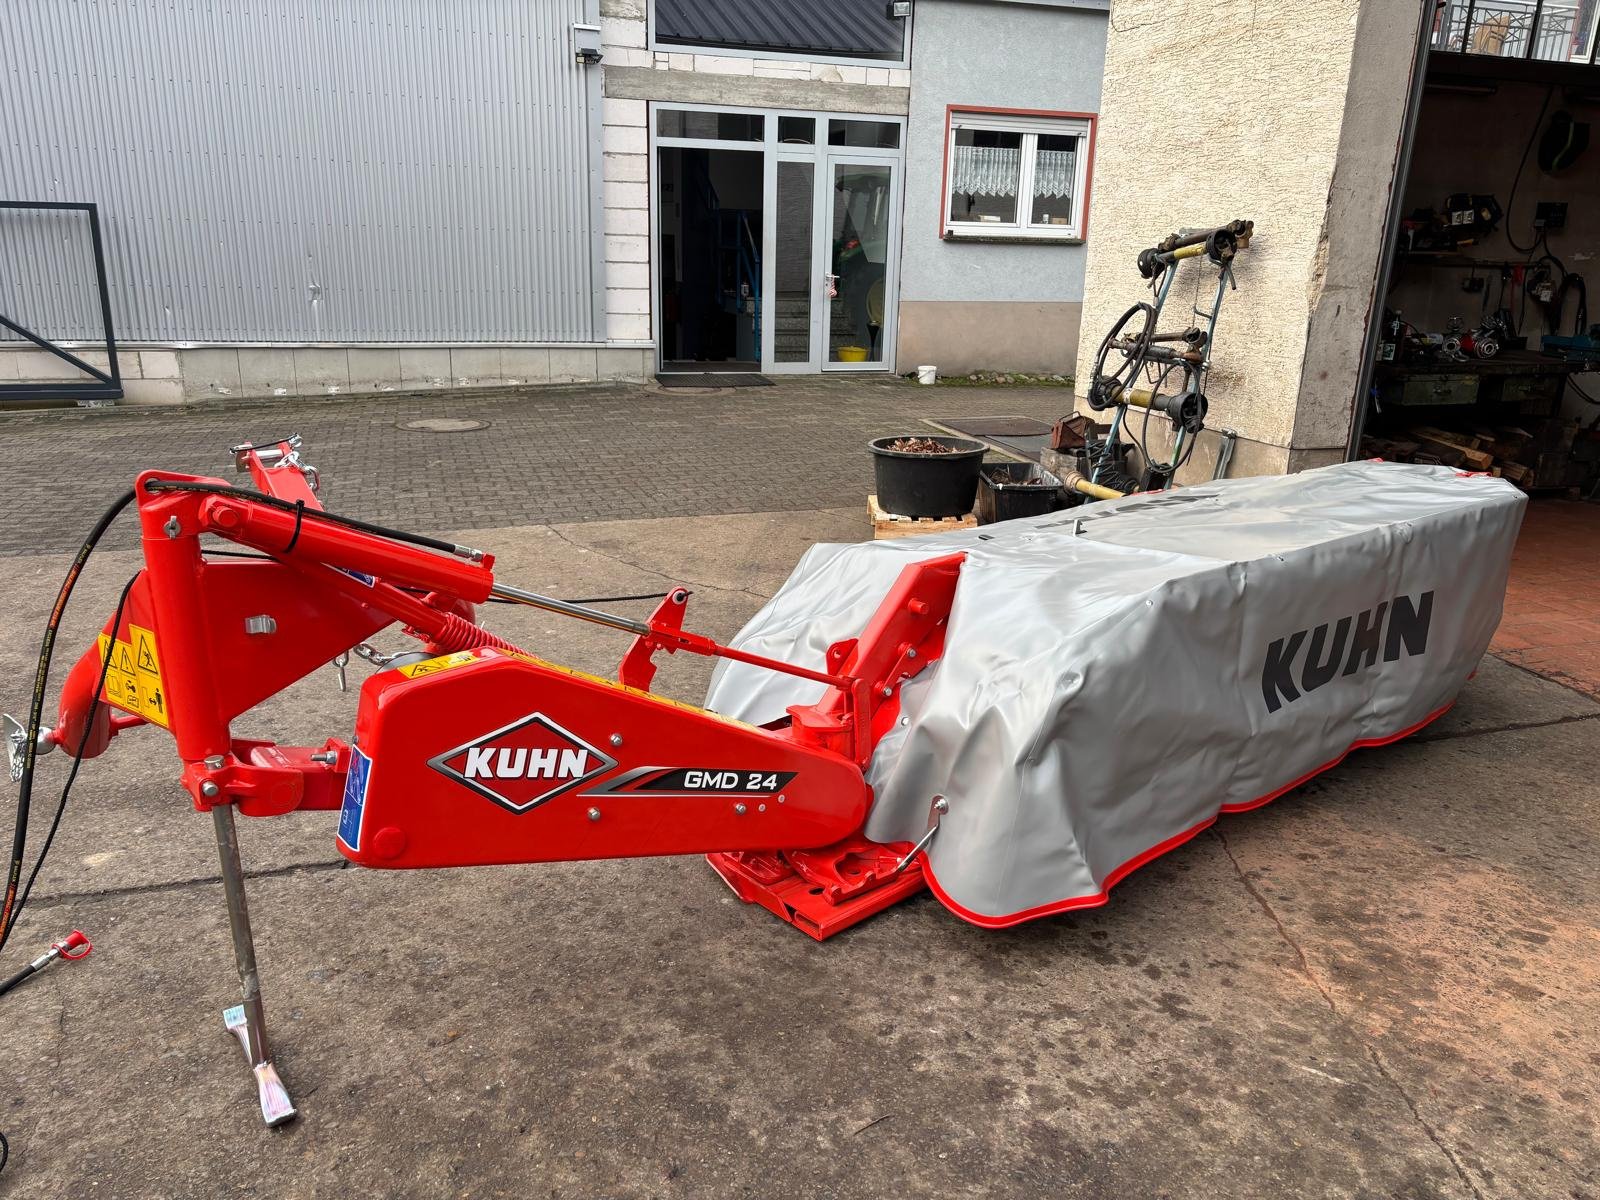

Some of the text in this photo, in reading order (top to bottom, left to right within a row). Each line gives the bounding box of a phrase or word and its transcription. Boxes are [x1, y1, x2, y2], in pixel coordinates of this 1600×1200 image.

[1262, 591, 1434, 713] KUHN
[464, 747, 588, 779] KUHN
[683, 771, 778, 790] GMD 24
